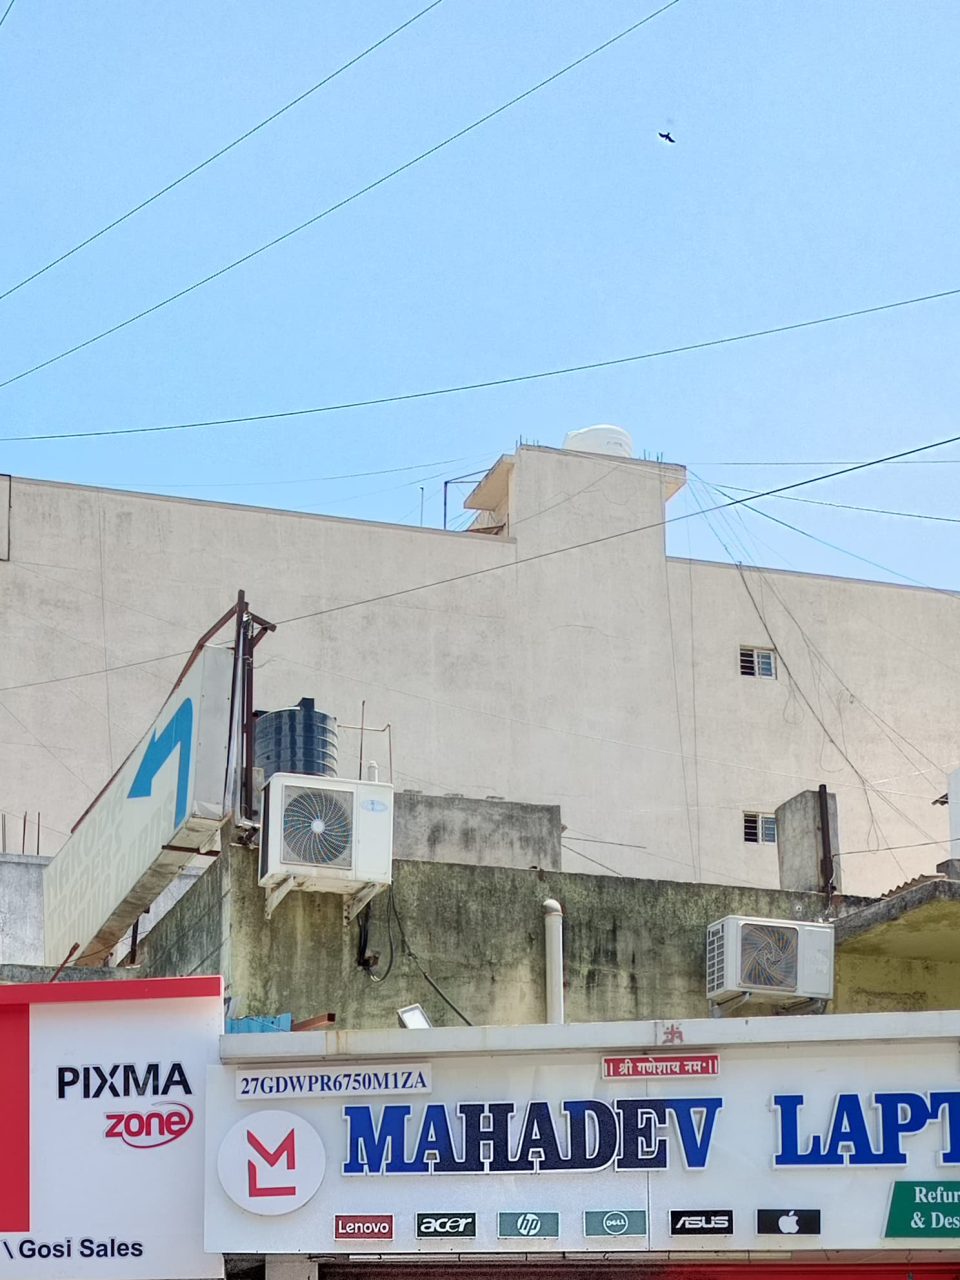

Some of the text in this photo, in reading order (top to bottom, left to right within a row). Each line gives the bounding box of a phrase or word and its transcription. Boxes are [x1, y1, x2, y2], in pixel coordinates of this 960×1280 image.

[619, 1059, 633, 1075] श्री
[637, 1058, 680, 1075] गणेशाय
[58, 1062, 192, 1099] PIXMA
[240, 1069, 428, 1096] 27GDWPR6750M1ZA
[105, 1105, 193, 1143] zone
[343, 1098, 723, 1174] MAHADEV
[338, 1220, 390, 1234] Lenovo
[420, 1215, 472, 1233] acer
[517, 1213, 541, 1236] hp
[676, 1216, 729, 1229] ASUS
[911, 1212, 960, 1228] & Des
[18, 1238, 72, 1259] Gosi
[80, 1237, 143, 1258] Sales
